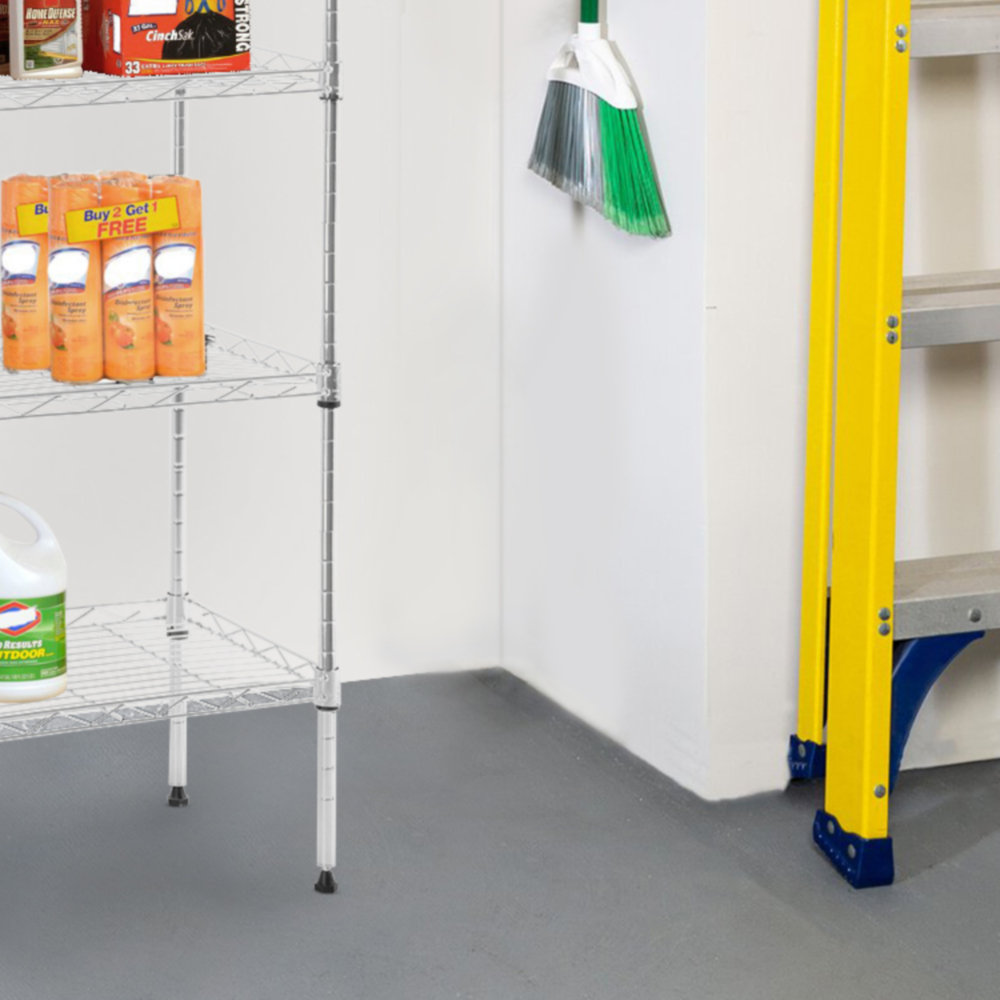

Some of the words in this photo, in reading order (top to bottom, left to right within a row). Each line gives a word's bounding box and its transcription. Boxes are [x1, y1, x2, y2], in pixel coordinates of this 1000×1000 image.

[25, 7, 47, 20] HOME
[47, 7, 76, 19] DEFENSE
[145, 28, 195, 43] CinchSak
[124, 60, 141, 74] 33
[34, 202, 48, 216] Bu
[83, 209, 110, 222] Buy
[112, 206, 122, 218] 2
[125, 202, 149, 216] Get
[151, 201, 158, 212] 1
[97, 216, 148, 238] FREE
[3, 639, 43, 649] RESULTS
